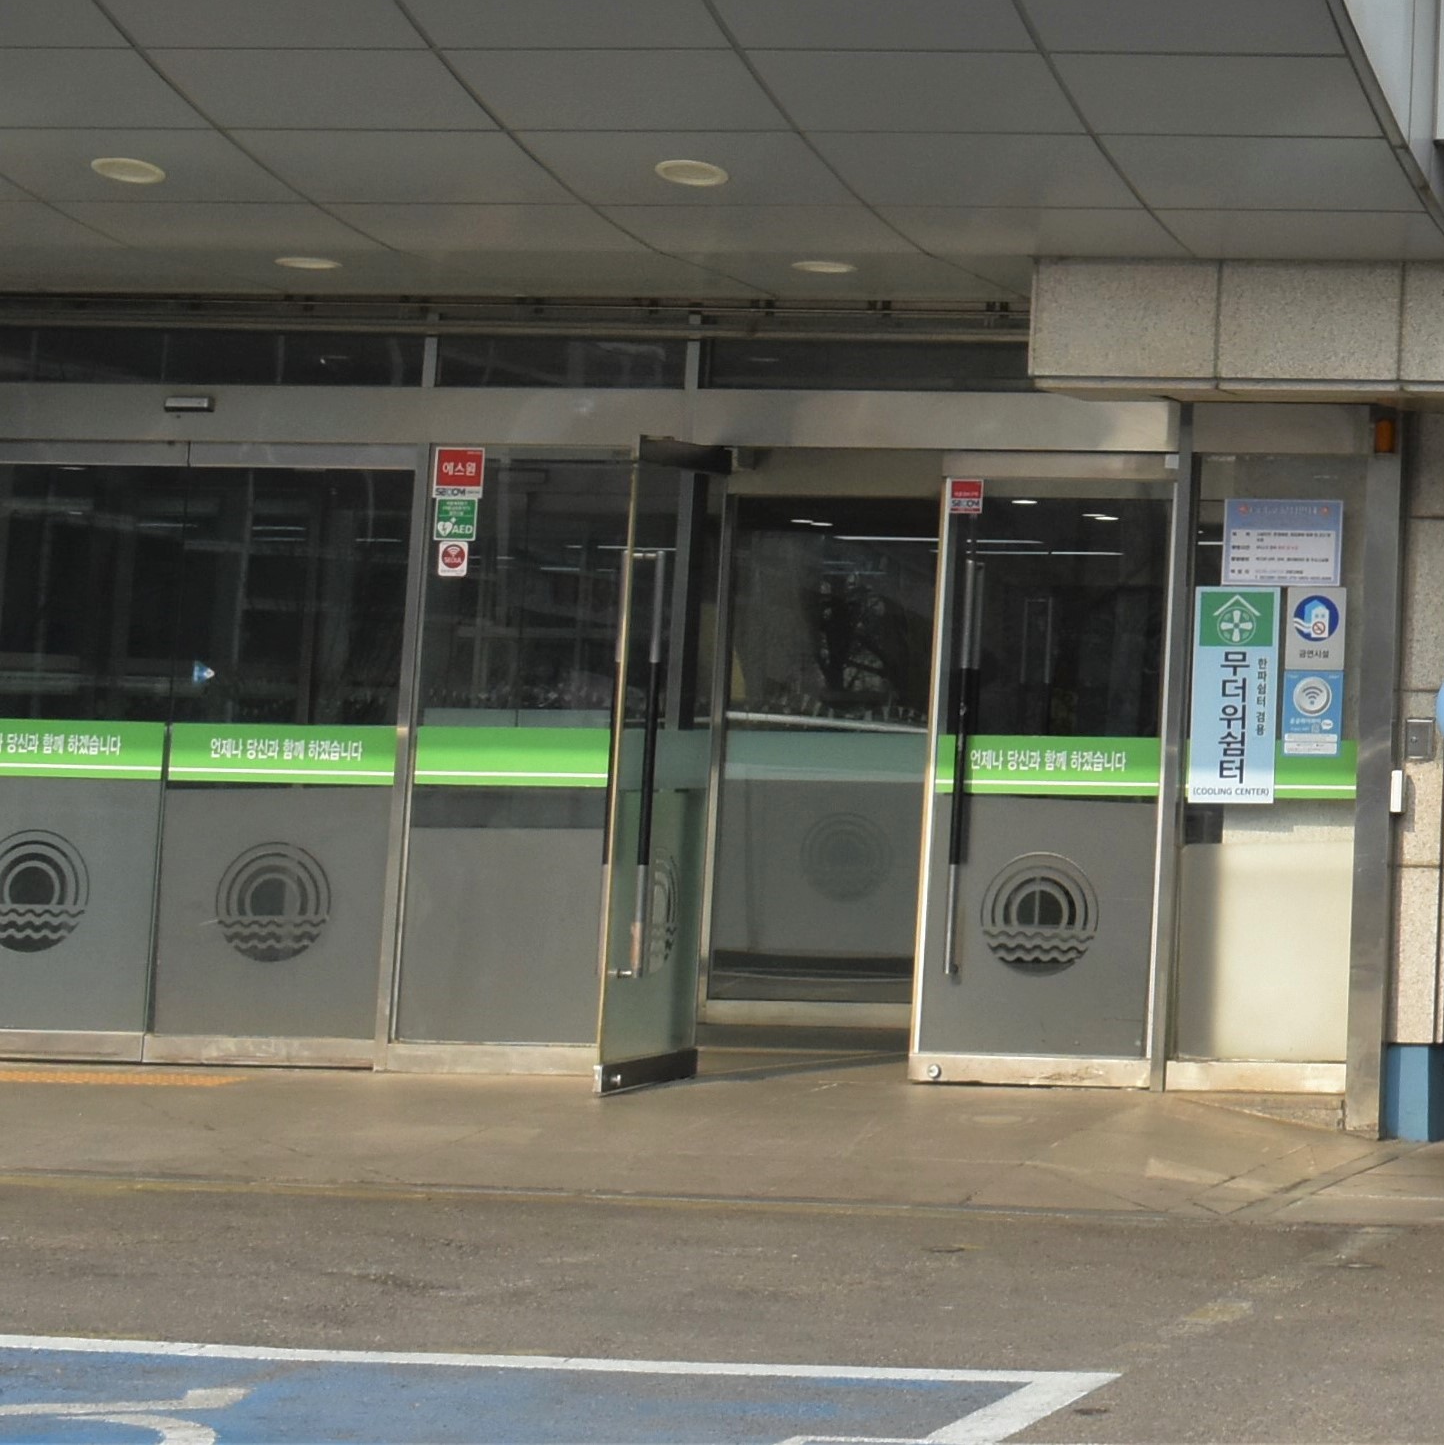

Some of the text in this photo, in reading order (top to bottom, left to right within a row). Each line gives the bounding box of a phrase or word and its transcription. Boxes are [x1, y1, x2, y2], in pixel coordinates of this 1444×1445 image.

[442, 461, 477, 477] 에스원
[452, 524, 474, 536] AED
[1255, 657, 1268, 737] 한파쉼터 겸용
[1218, 650, 1251, 785] 무더위쉼터
[7, 733, 39, 754] 당신과
[43, 733, 65, 755] 함께
[68, 734, 121, 756] 하겠습니다
[210, 738, 363, 762] 언제나 당신과 함께 하겠습니다
[970, 748, 1127, 772] 언제나 당신과 함께 하겠습니다
[1193, 787, 1270, 797] (COOLING CENTER)
